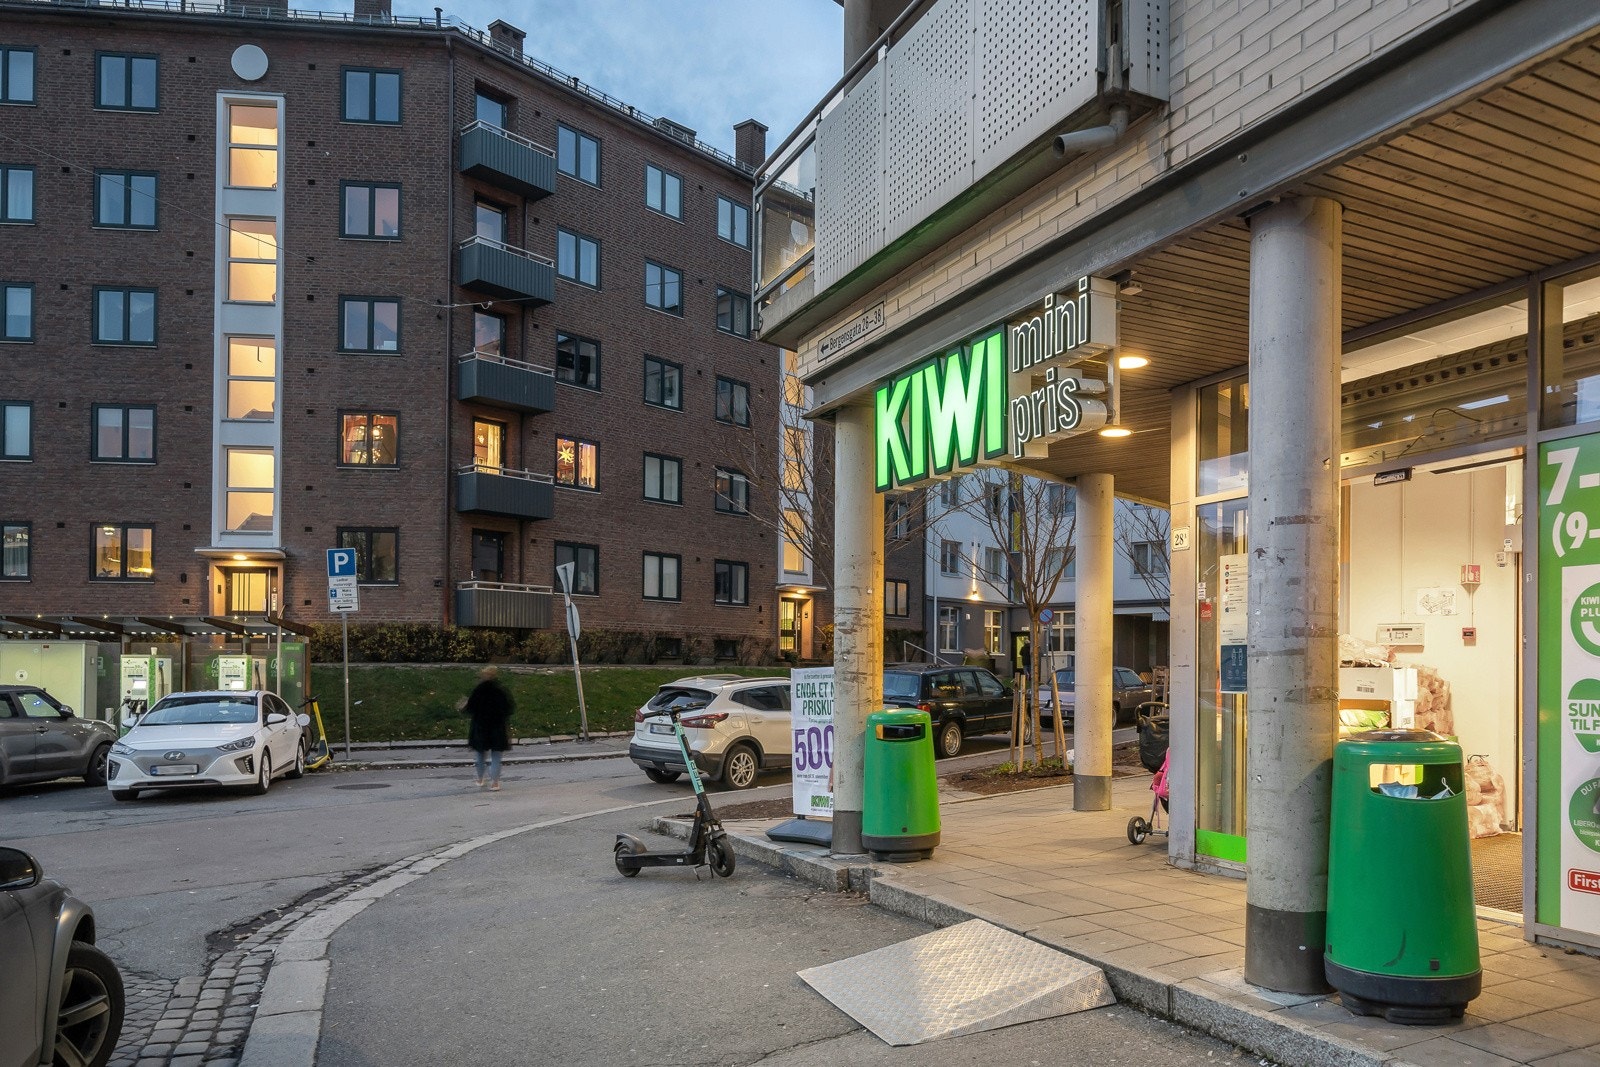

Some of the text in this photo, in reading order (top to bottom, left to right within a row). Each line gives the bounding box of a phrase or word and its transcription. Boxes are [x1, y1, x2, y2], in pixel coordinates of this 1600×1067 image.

[1012, 275, 1089, 373] mini
[875, 328, 1005, 490] KIWI
[1011, 367, 1080, 459] pris
[334, 552, 349, 574] P
[1580, 596, 1600, 605] KIWI
[796, 682, 817, 699] ENDA
[818, 681, 829, 698] ET
[802, 699, 834, 716] PRISKU
[1570, 718, 1591, 731] TIL
[1580, 784, 1592, 796] DU
[1573, 819, 1596, 828] LIBERO
